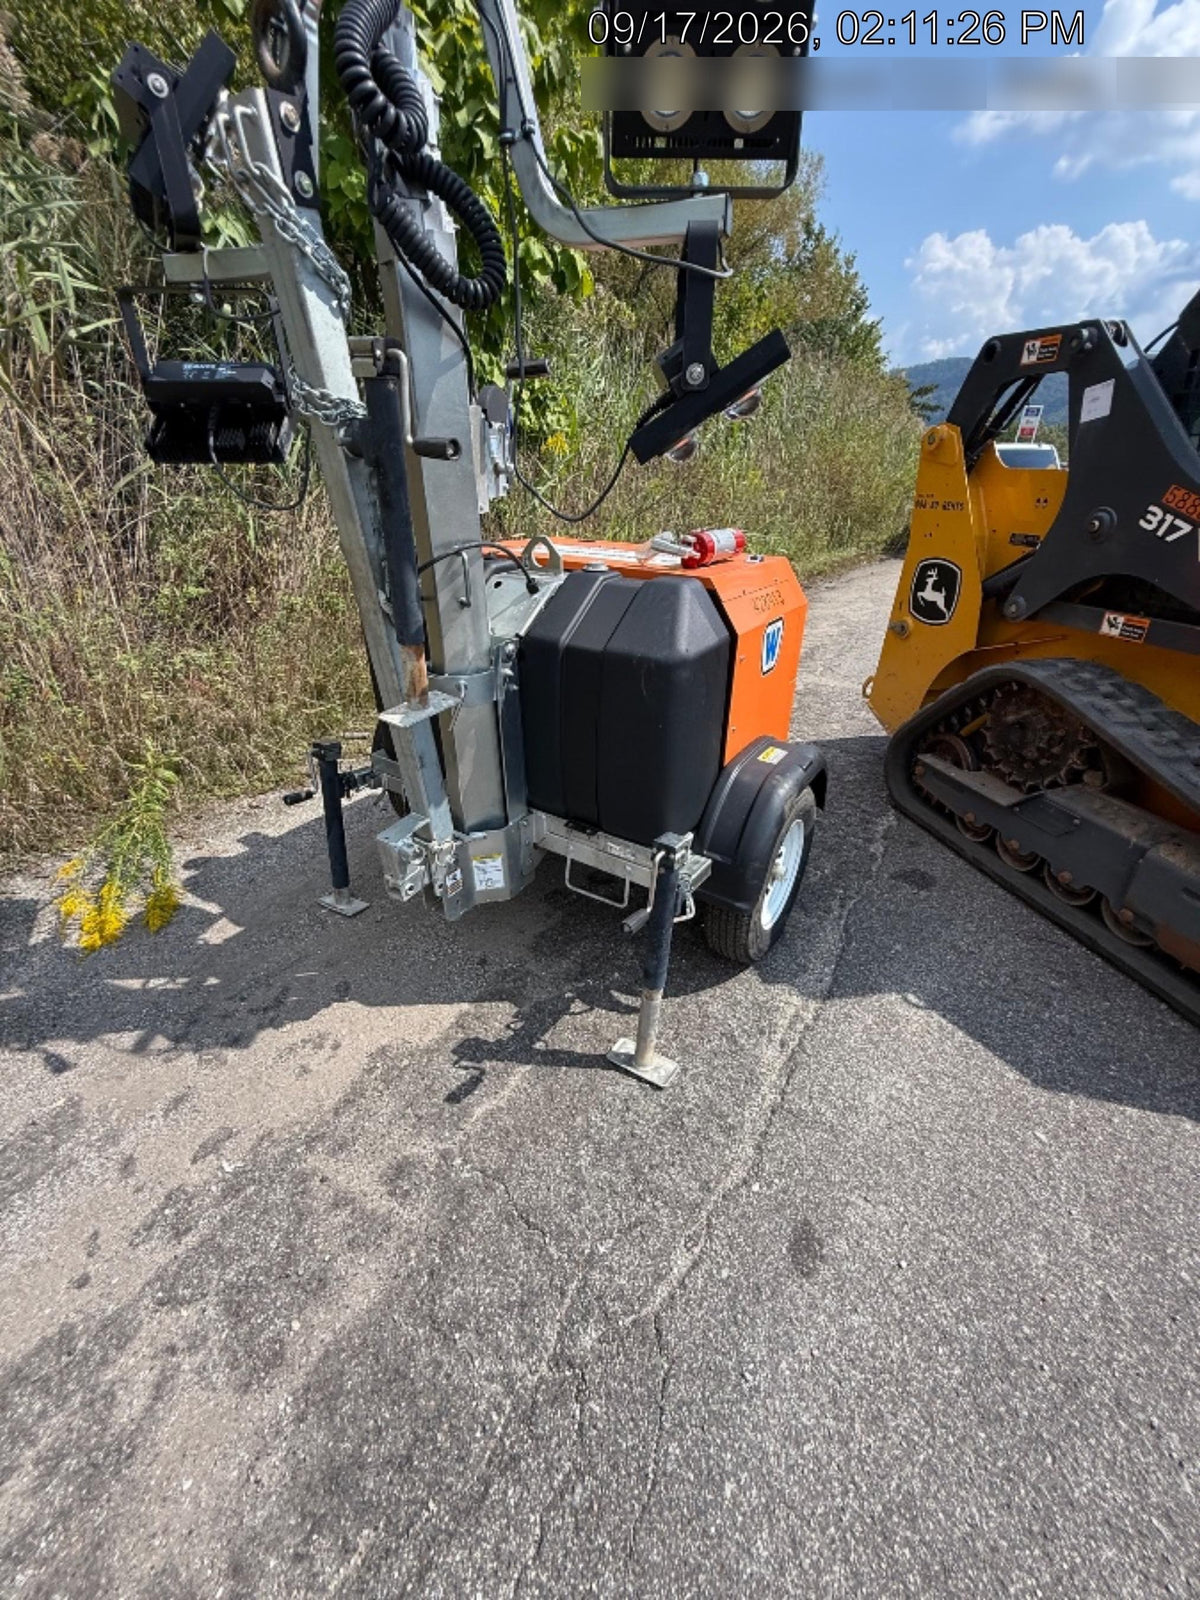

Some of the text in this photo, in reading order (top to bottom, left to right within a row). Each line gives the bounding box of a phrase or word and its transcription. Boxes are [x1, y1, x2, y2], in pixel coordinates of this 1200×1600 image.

[1165, 486, 1200, 520] 588
[1138, 504, 1193, 542] 317
[765, 626, 781, 665] W
